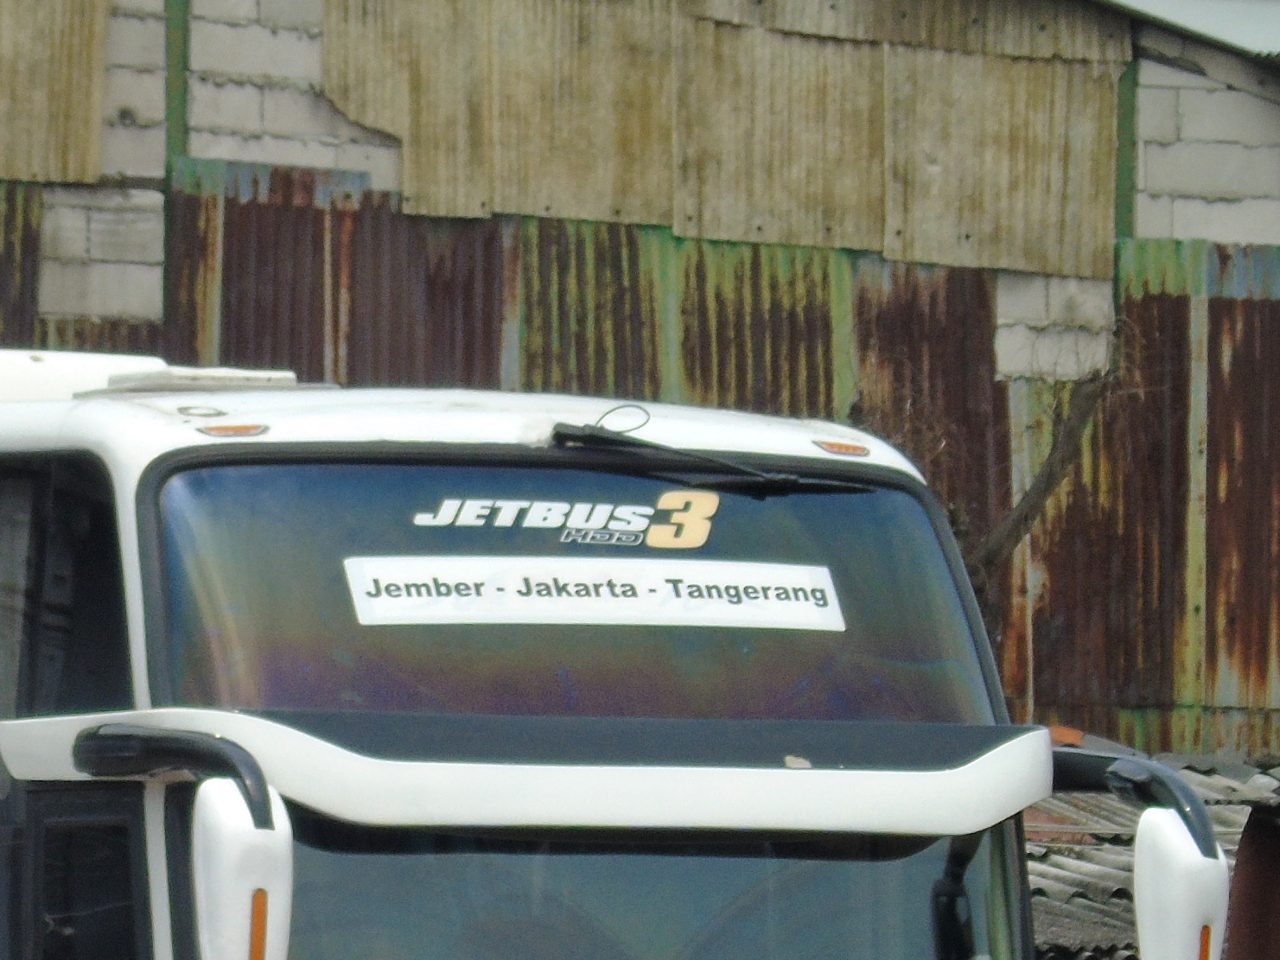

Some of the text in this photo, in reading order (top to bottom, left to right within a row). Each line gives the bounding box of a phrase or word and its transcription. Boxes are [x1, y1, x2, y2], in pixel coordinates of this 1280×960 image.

[413, 489, 720, 549] JETBUS 3
[365, 576, 485, 600] Jember
[516, 576, 639, 599] Jakarta
[666, 578, 829, 607] Tangerang
